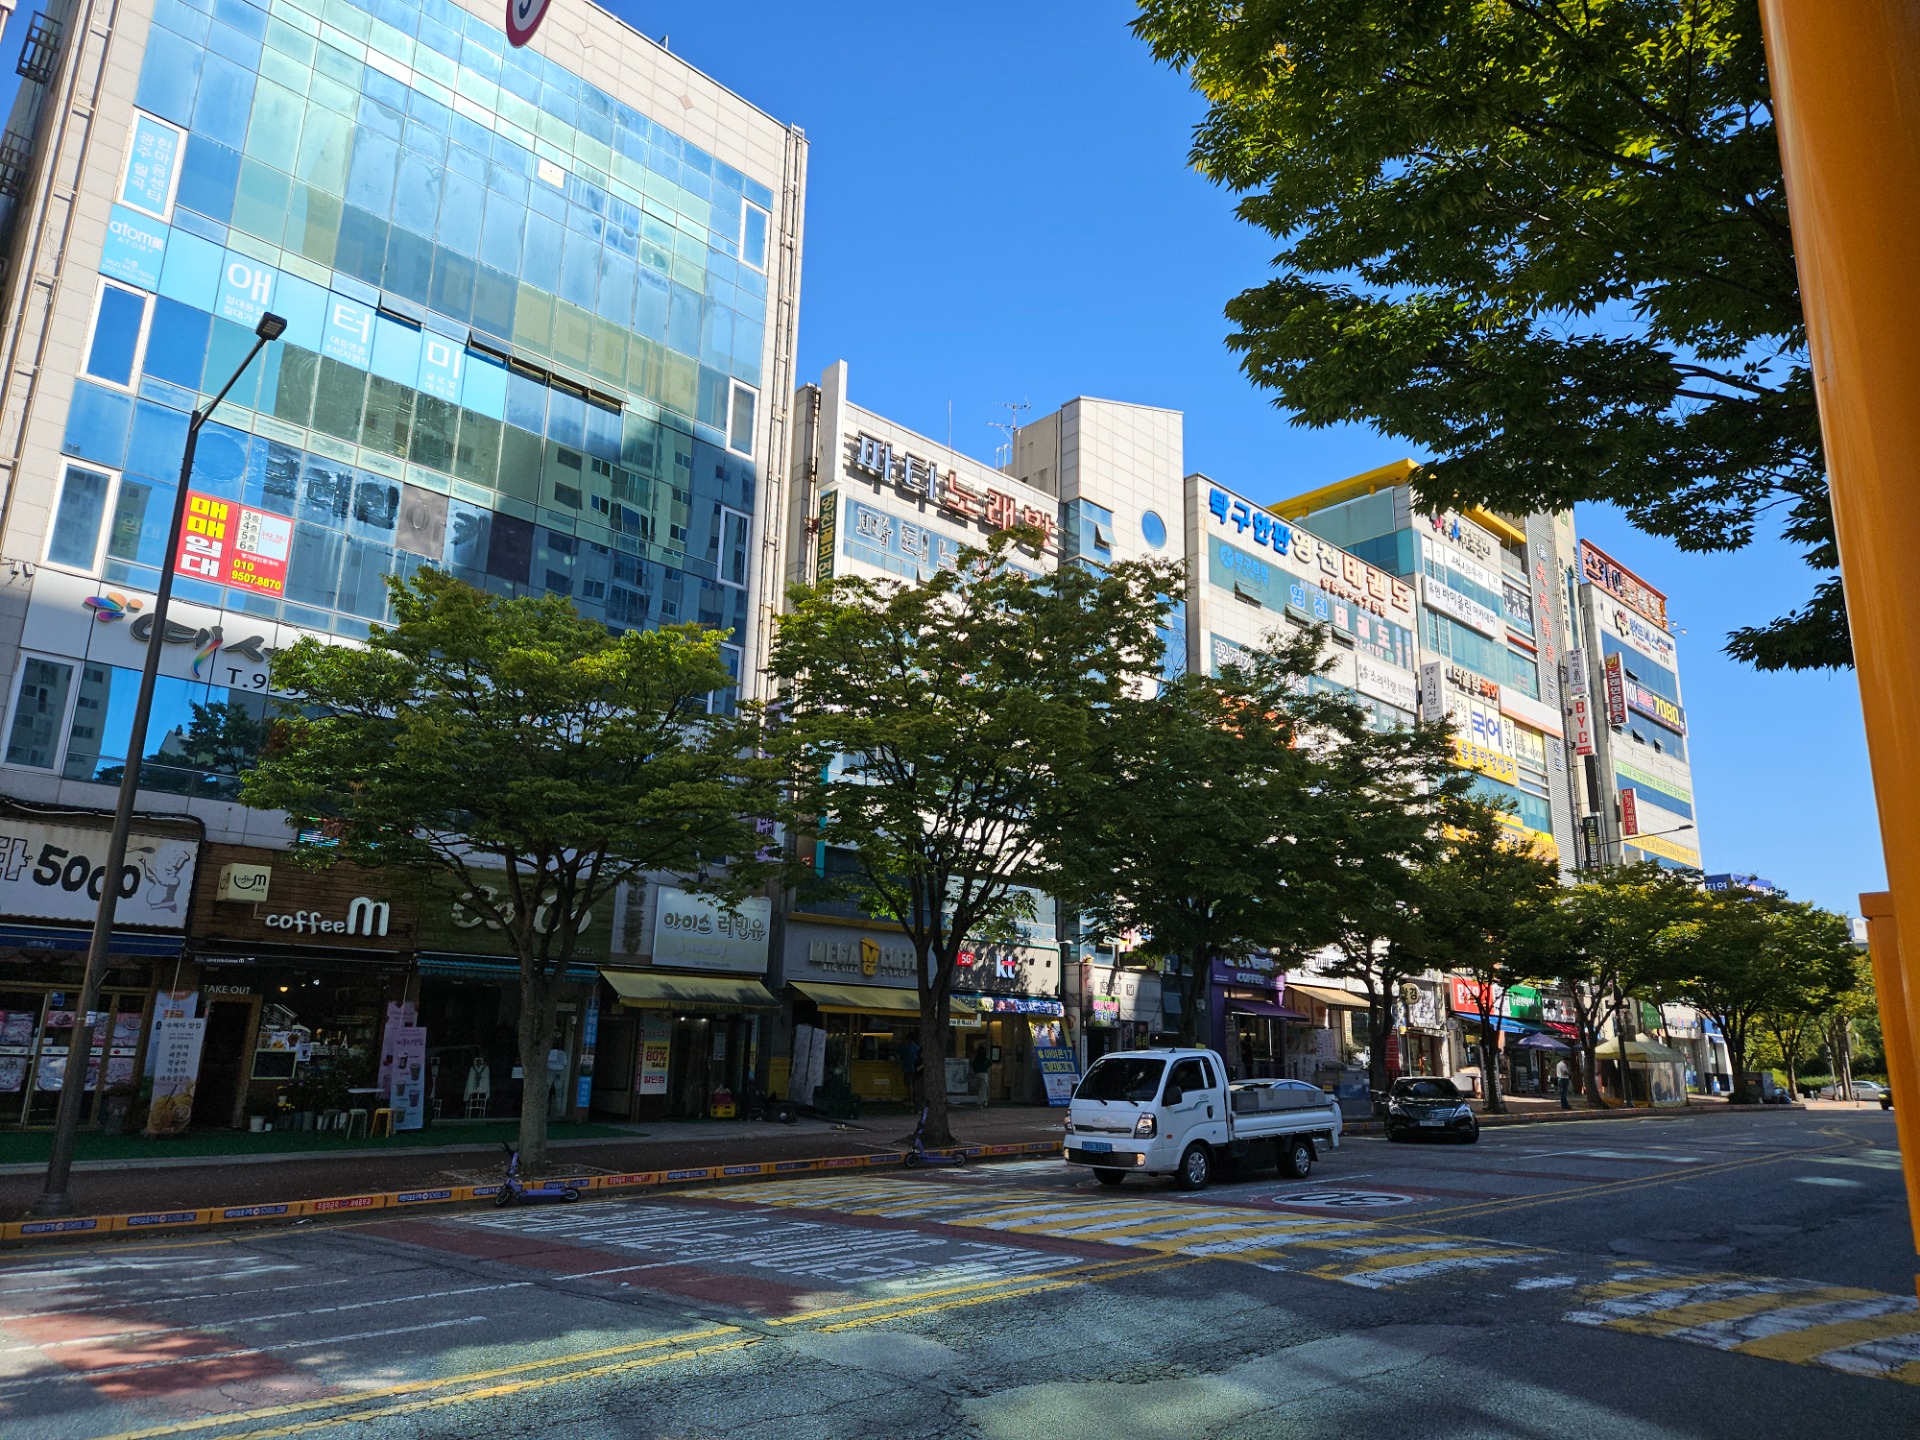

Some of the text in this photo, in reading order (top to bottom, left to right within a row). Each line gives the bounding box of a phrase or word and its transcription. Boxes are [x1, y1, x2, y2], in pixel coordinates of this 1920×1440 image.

[117, 236, 154, 254] ATOMY
[1209, 487, 1292, 556] 탁구한판
[233, 559, 254, 571] 010
[1442, 589, 1472, 616] 바이올린
[1473, 606, 1496, 626] 아카데미
[1371, 670, 1397, 694] 소리사랑
[1575, 700, 1588, 744] BYC
[1653, 695, 1680, 726] 7080
[1472, 710, 1503, 747] 국어
[1461, 743, 1515, 783] 운동발달센터
[664, 912, 766, 941] 아이스 러빙유
[809, 939, 859, 966] MEGA
[961, 954, 972, 964] 5G
[822, 964, 839, 972] BIG
[888, 969, 911, 977] SHOT
[996, 954, 1016, 979] kt
[1236, 972, 1265, 985] COFFEE
[202, 984, 252, 996] TAKE OUT
[645, 1050, 667, 1062] 80%
[1044, 1049, 1073, 1060] 아이폰17
[643, 1075, 665, 1084] 할인점
